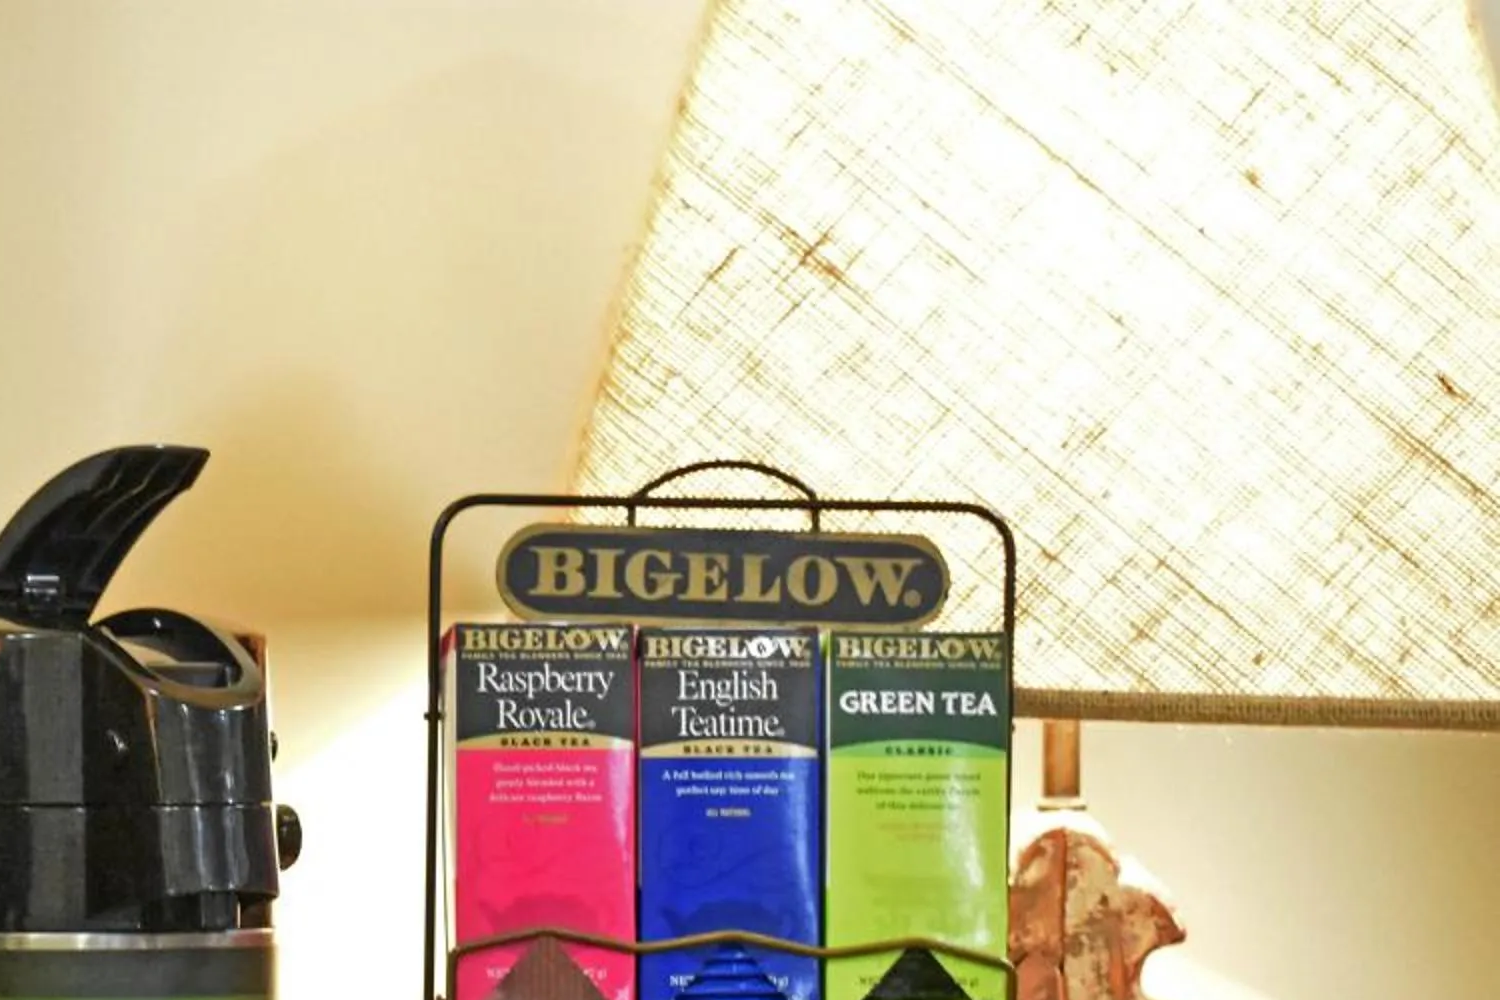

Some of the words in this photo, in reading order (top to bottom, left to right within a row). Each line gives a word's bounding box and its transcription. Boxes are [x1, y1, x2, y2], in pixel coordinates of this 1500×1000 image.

[464, 628, 628, 651] BIGELOW
[645, 635, 809, 659] BIGELOW
[837, 637, 999, 659] BIGELOW
[477, 661, 615, 700] Raspberry
[677, 669, 778, 706] English
[496, 698, 589, 733] Royale
[839, 690, 935, 715] GREEN
[941, 691, 997, 716] TEA
[671, 706, 781, 737] Teatime
[501, 736, 553, 747] BLACK
[560, 736, 591, 747] TEA
[743, 745, 773, 754] TEA
